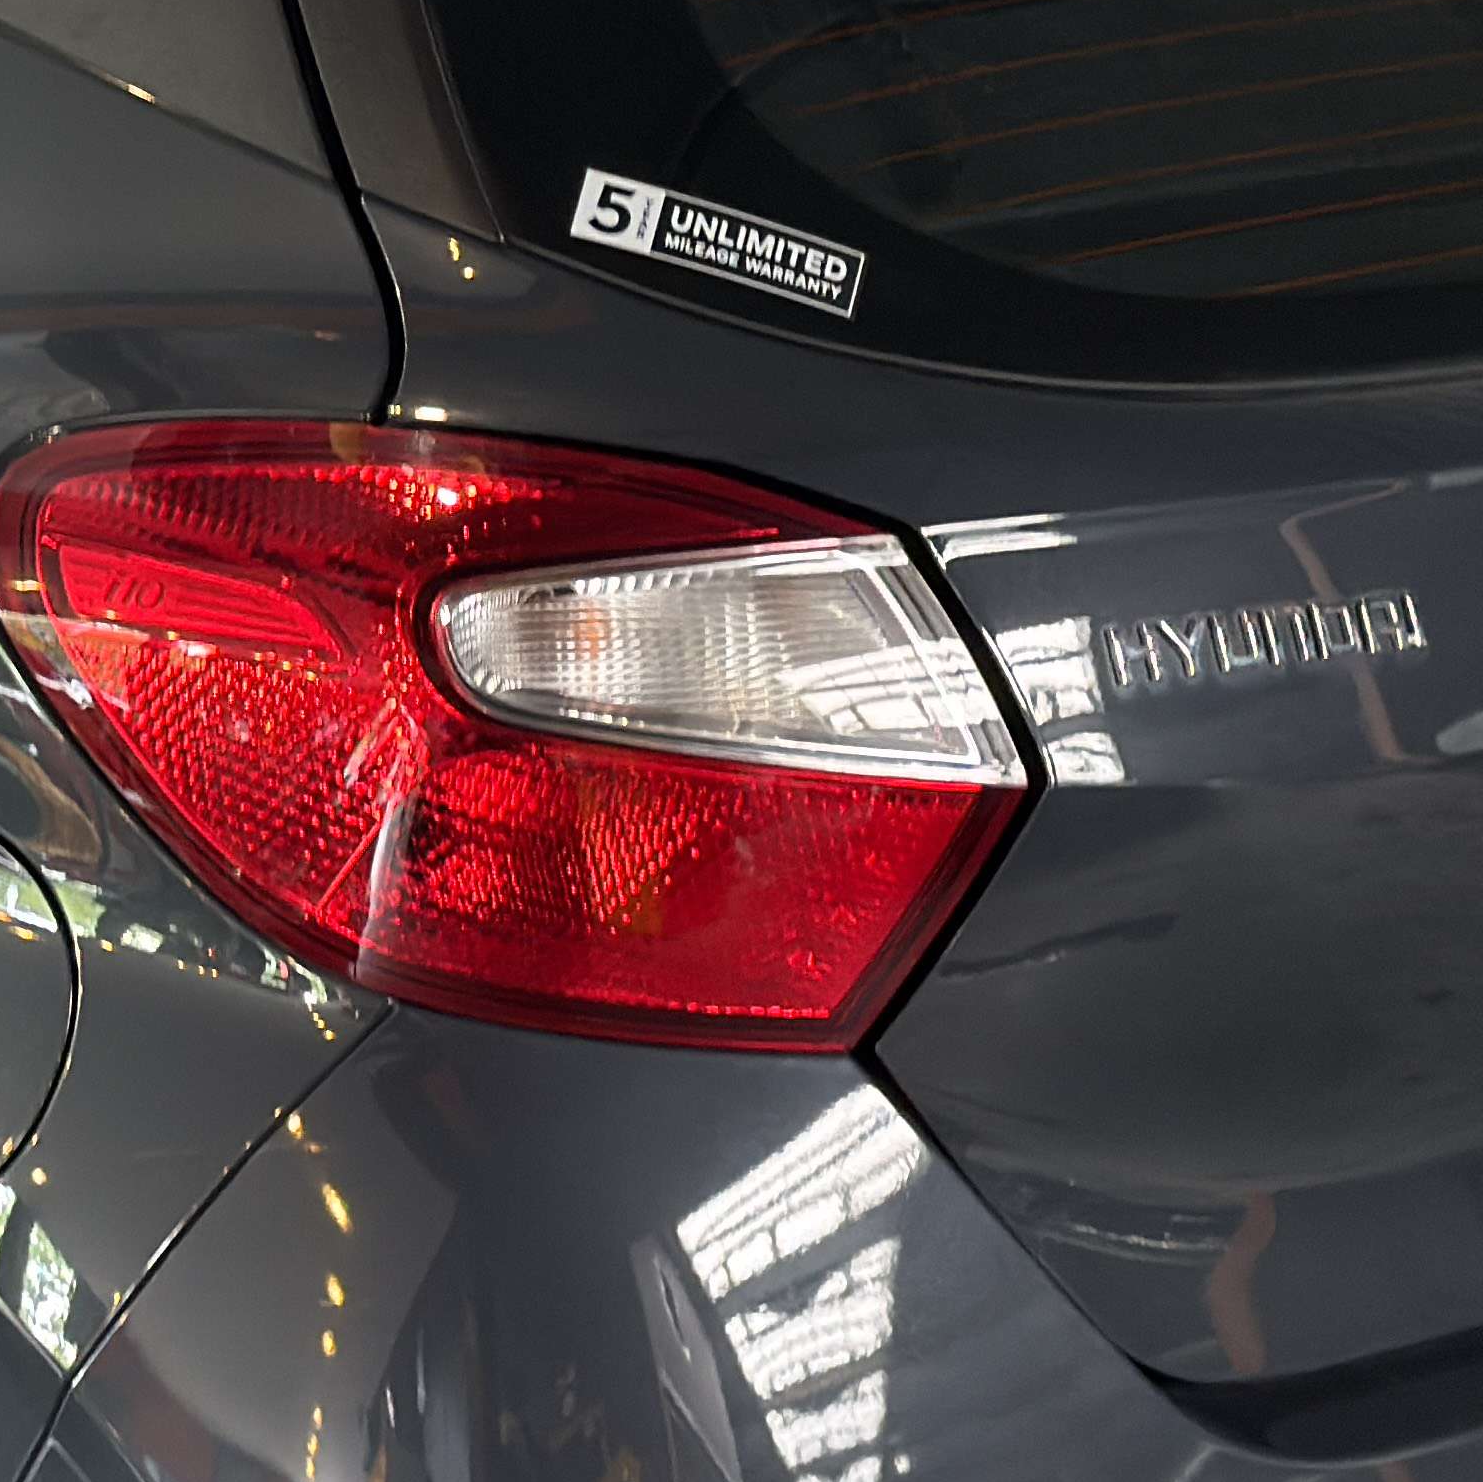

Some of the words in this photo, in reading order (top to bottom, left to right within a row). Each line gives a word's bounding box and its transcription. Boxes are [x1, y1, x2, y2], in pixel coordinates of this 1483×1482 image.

[587, 183, 637, 235] 5
[670, 204, 848, 283] UNLIMITED
[664, 231, 740, 269] MILEAGE
[744, 254, 844, 301] WARRANTY
[1103, 589, 1429, 687] HYUNDAI
